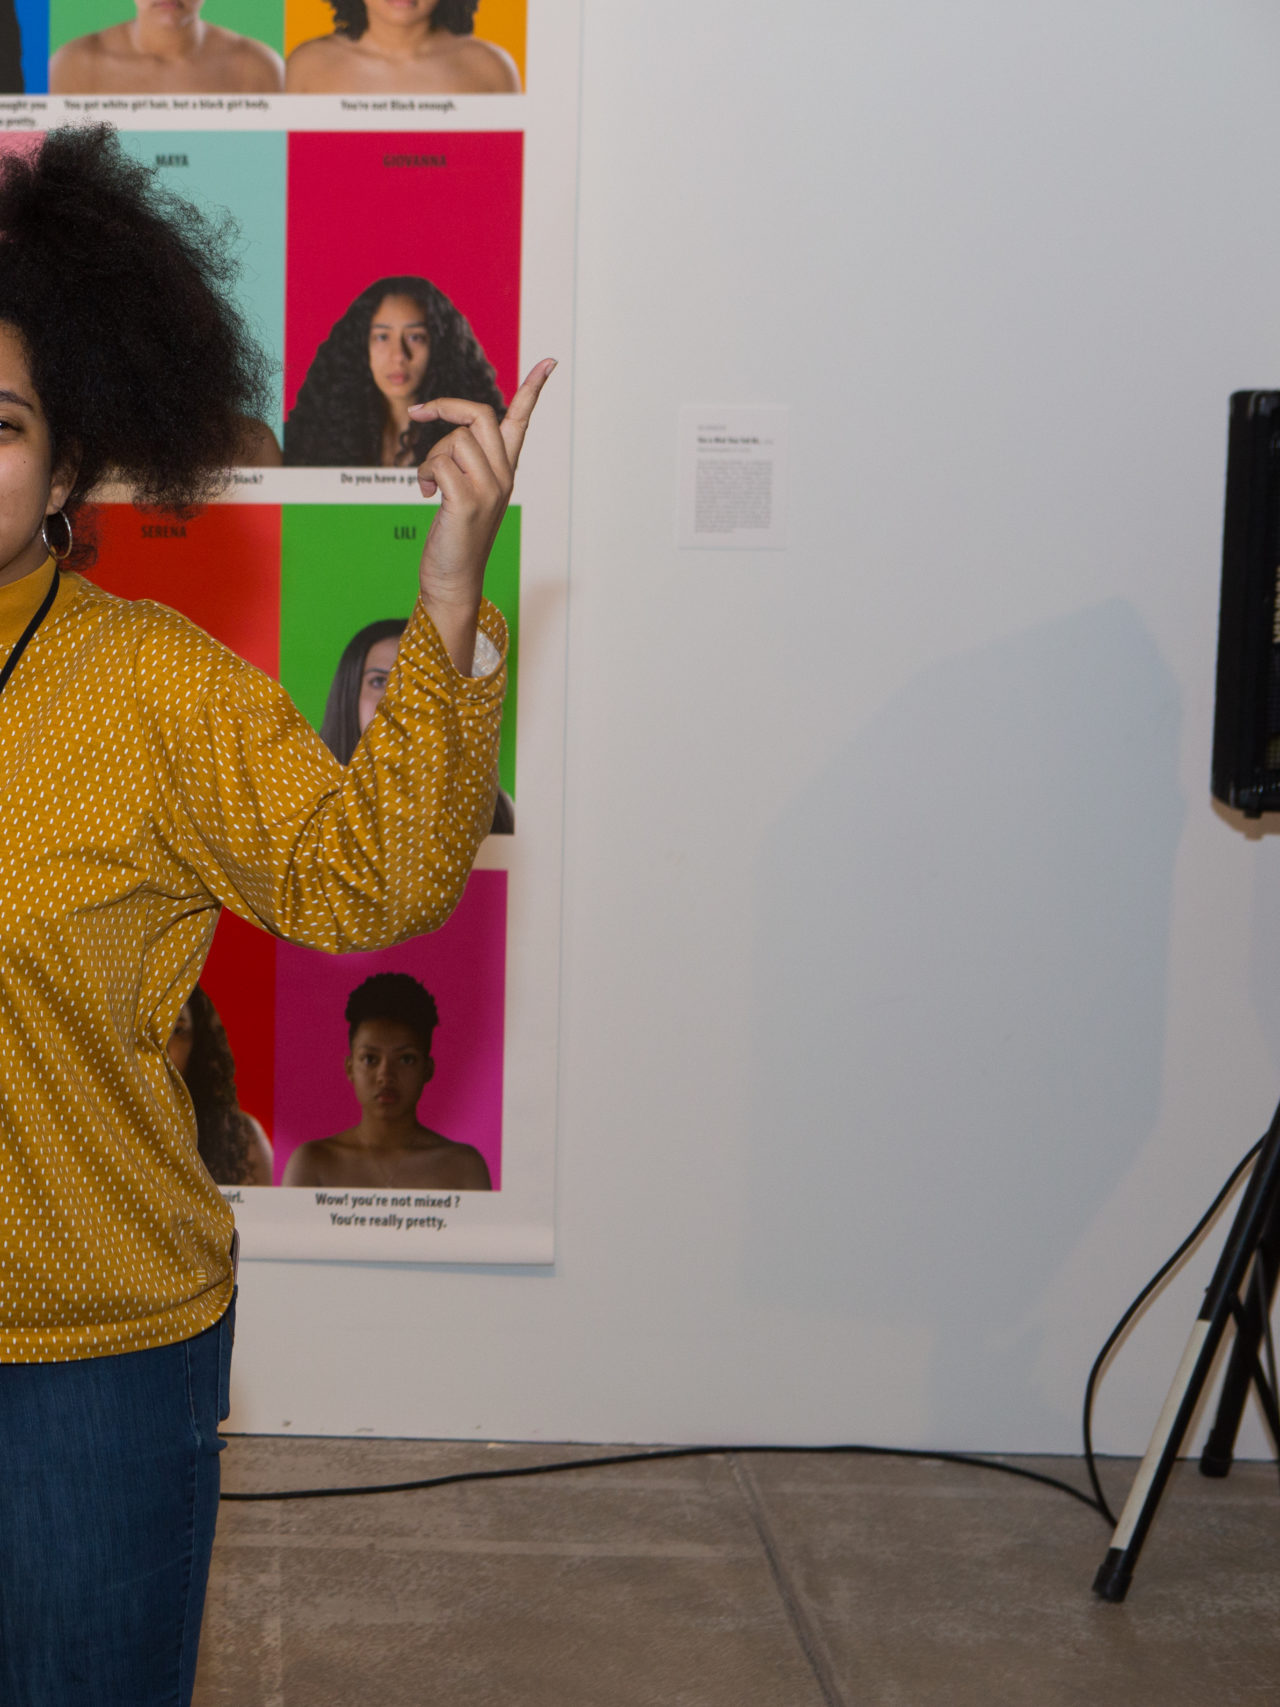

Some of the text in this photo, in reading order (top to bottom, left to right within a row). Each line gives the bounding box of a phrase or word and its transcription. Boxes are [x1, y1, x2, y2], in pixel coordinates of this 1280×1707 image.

[341, 100, 457, 112] You're not Black enough.
[156, 154, 189, 168] MAYA
[383, 154, 448, 168] GIOVANNA
[341, 473, 353, 484] Do
[356, 476, 372, 486] you
[374, 473, 396, 484] have
[140, 526, 187, 539] SERENA
[394, 526, 416, 540] LILI
[315, 1192, 348, 1206] Wow!
[351, 1194, 388, 1209] you're
[391, 1195, 412, 1207] not
[414, 1194, 451, 1208] mixed
[330, 1213, 448, 1231] You're really pretty.
